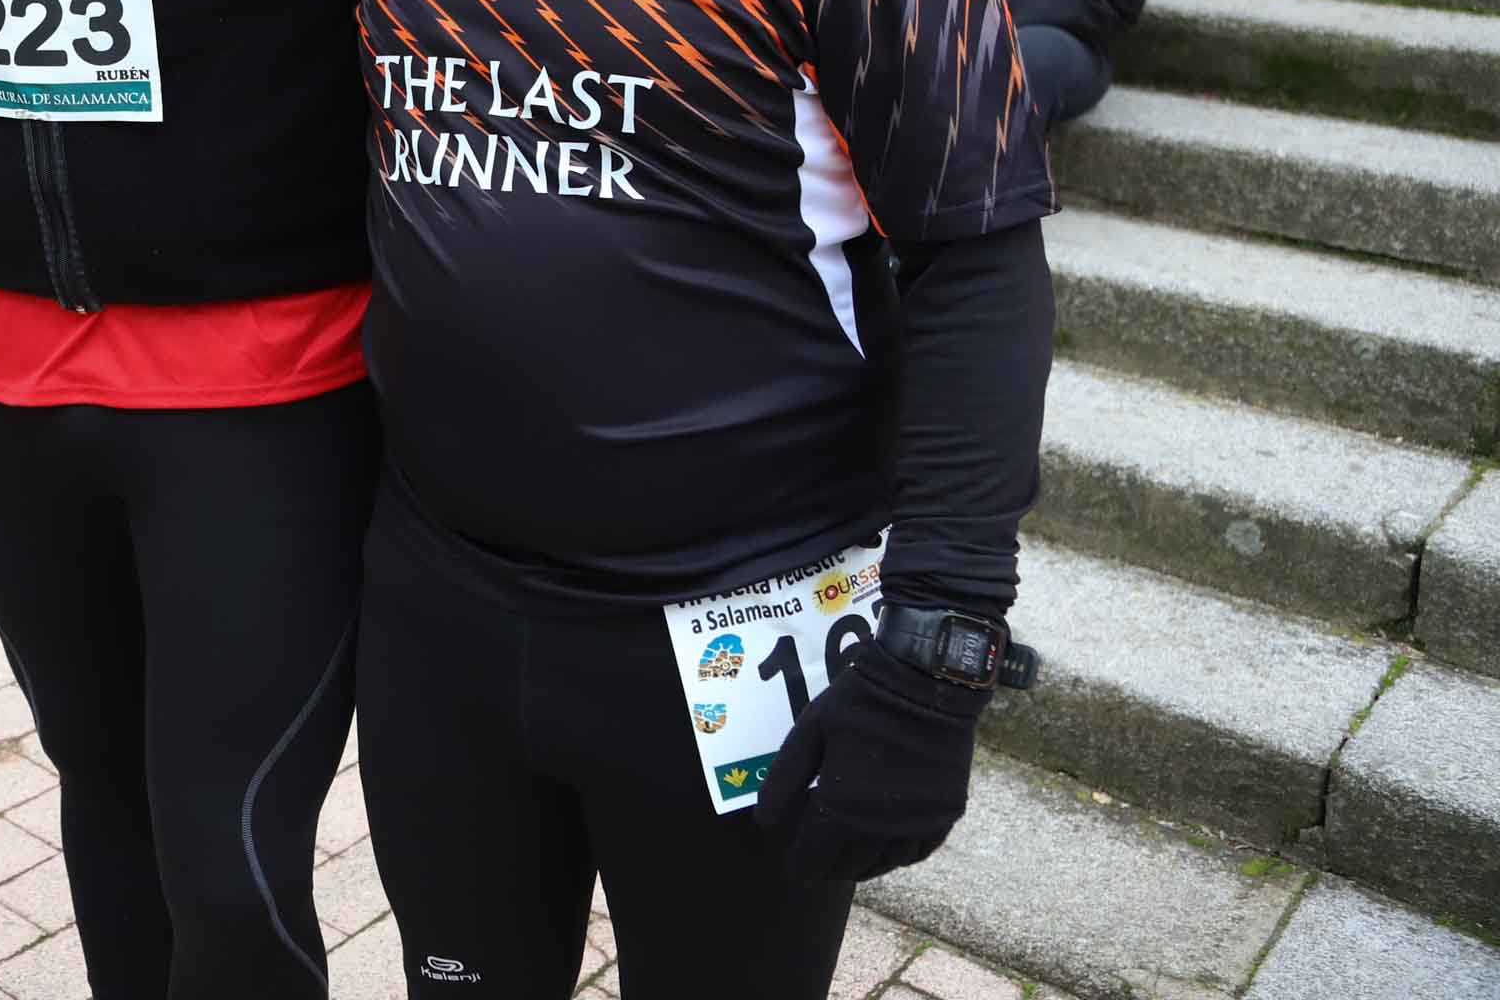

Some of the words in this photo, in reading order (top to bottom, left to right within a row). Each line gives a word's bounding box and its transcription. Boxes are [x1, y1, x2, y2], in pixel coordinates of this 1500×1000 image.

[96, 66, 150, 81] RUBÉN
[32, 92, 52, 105] DE
[54, 91, 150, 105] SALAMANCA
[376, 56, 468, 112] THE
[488, 60, 654, 134] LAST
[388, 129, 645, 200] RUNNER
[815, 562, 884, 605] TOURsa
[691, 618, 703, 634] a
[706, 597, 804, 631] Salamanca
